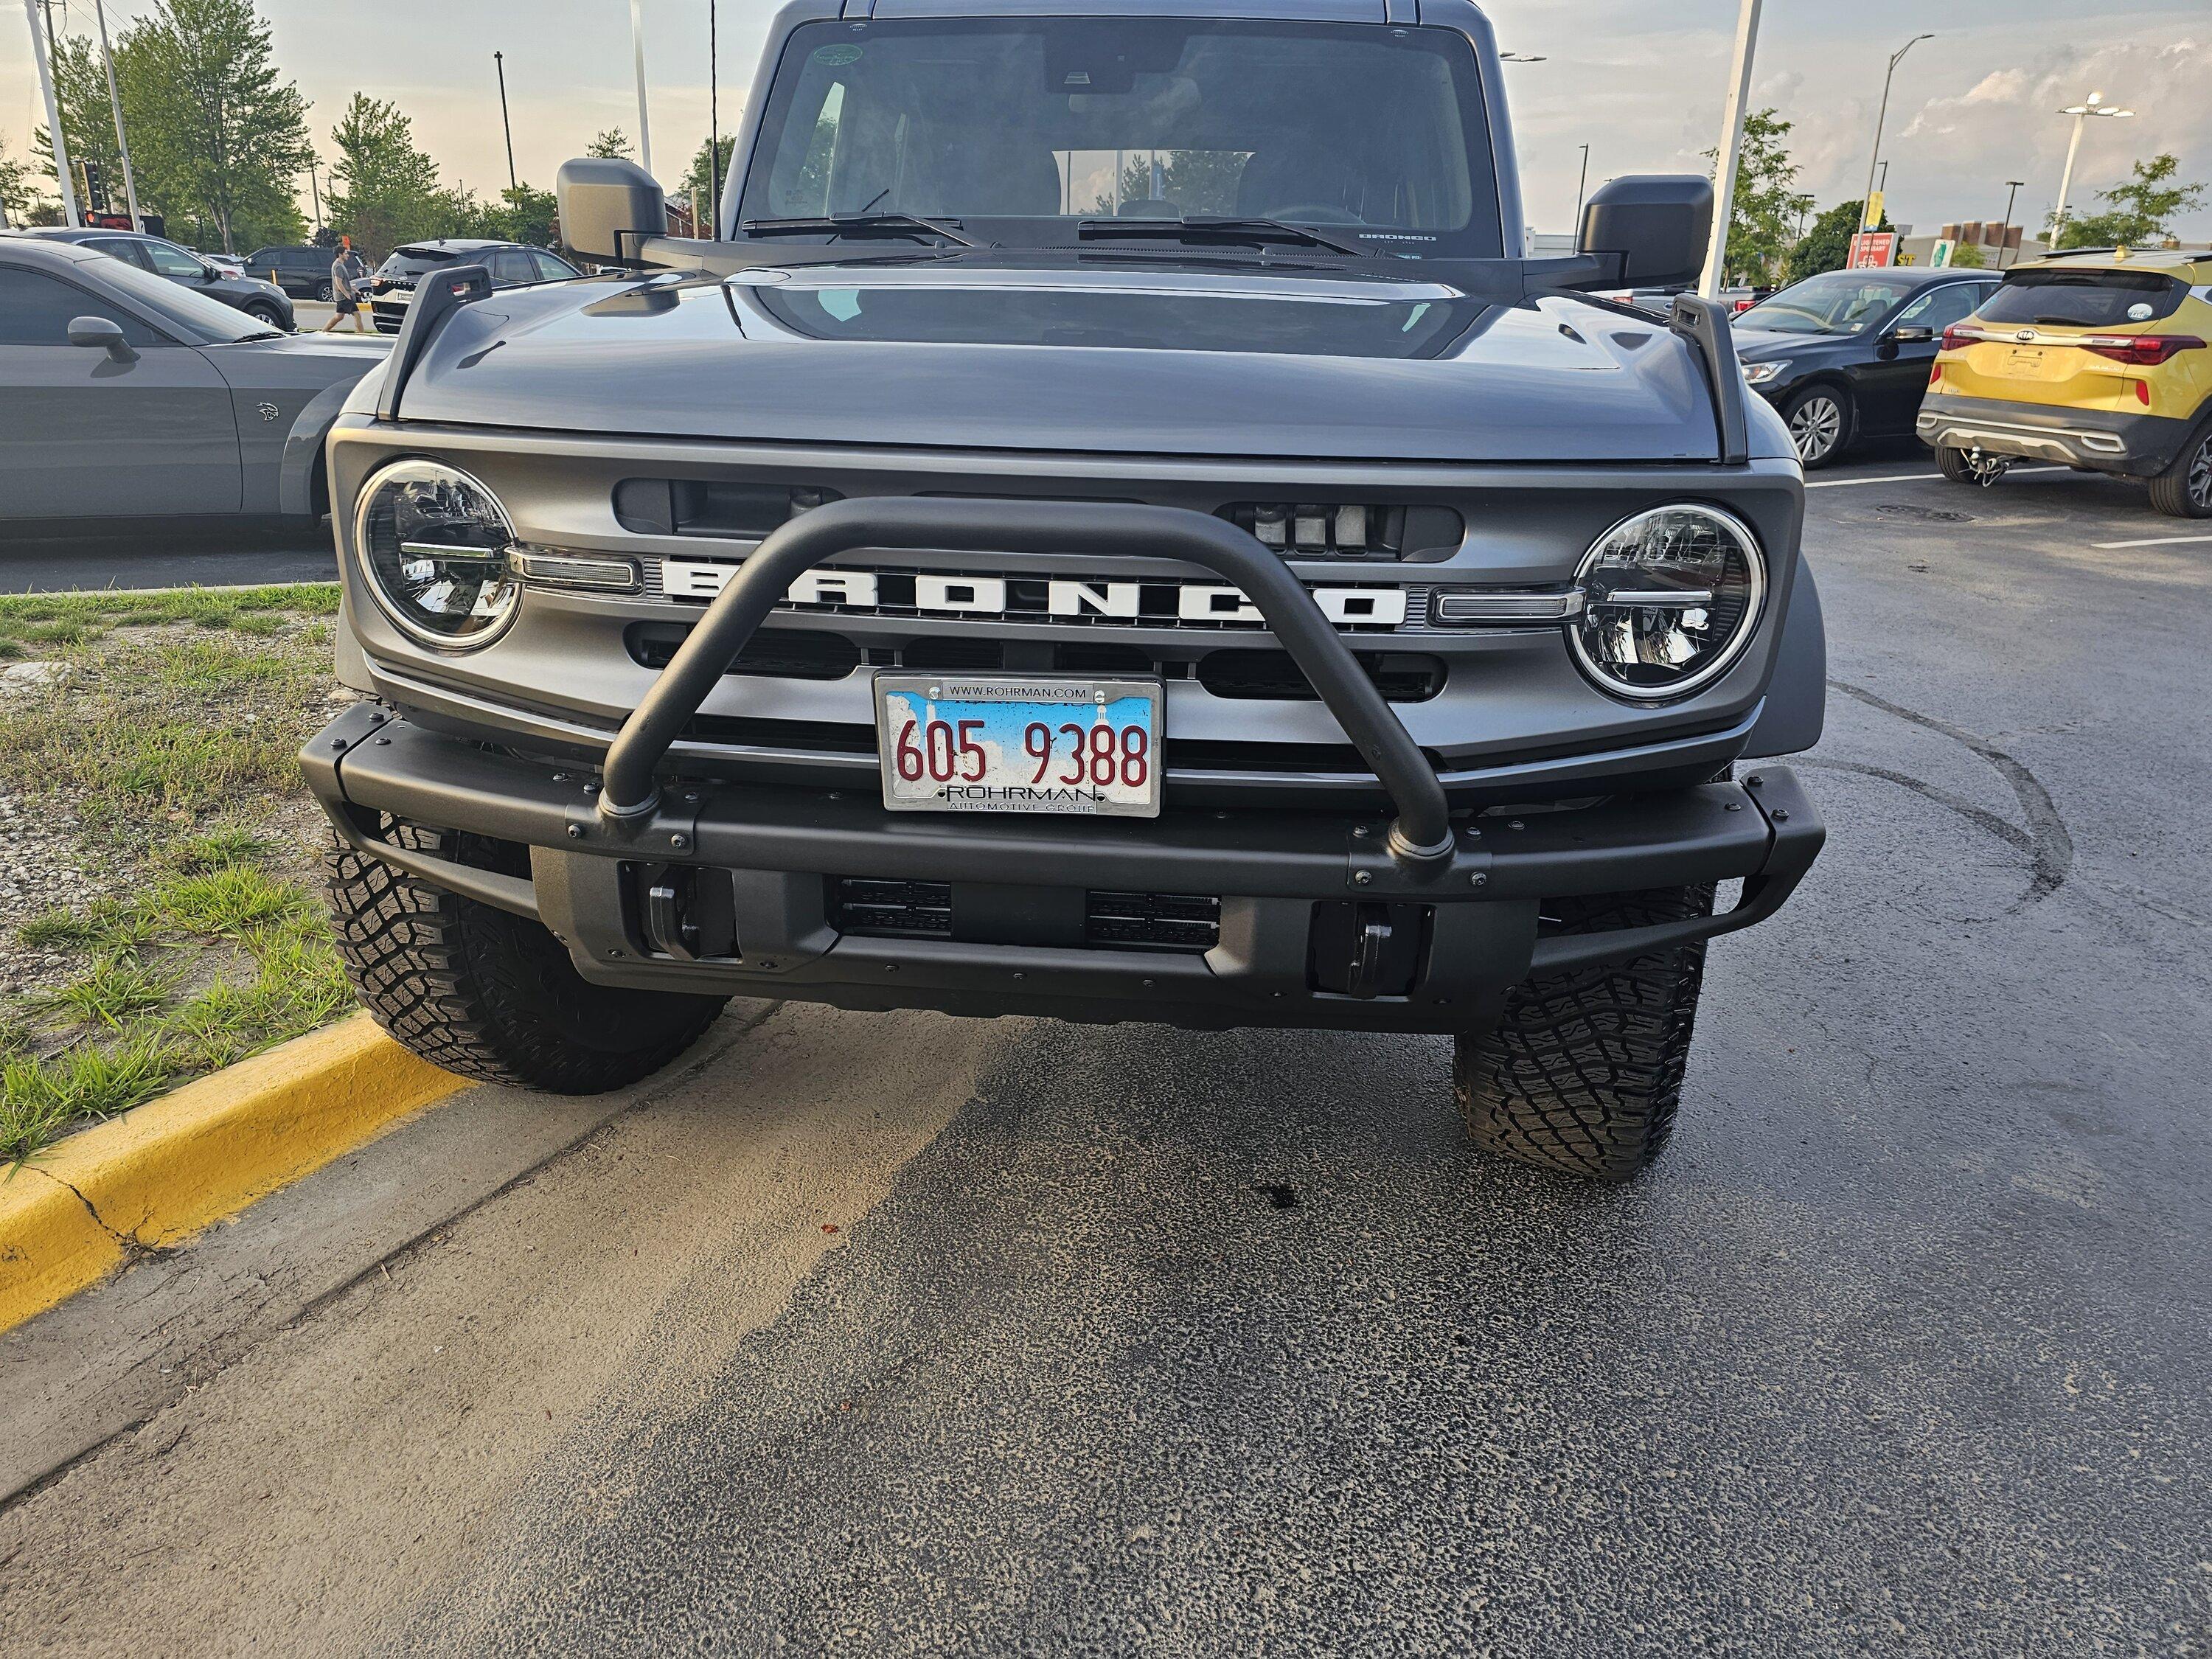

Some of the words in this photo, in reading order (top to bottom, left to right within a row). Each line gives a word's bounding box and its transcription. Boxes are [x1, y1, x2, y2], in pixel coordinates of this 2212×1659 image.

[663, 560, 1407, 624] BRONCO
[949, 686, 1086, 698] WWW.ROHRMAN.COM
[897, 720, 987, 782] 605
[1024, 722, 1147, 787] 9388
[947, 785, 1097, 801] ROHRMAN
[948, 802, 1040, 811] AUTOMOTIVE
[1046, 804, 1095, 813] GROUP
